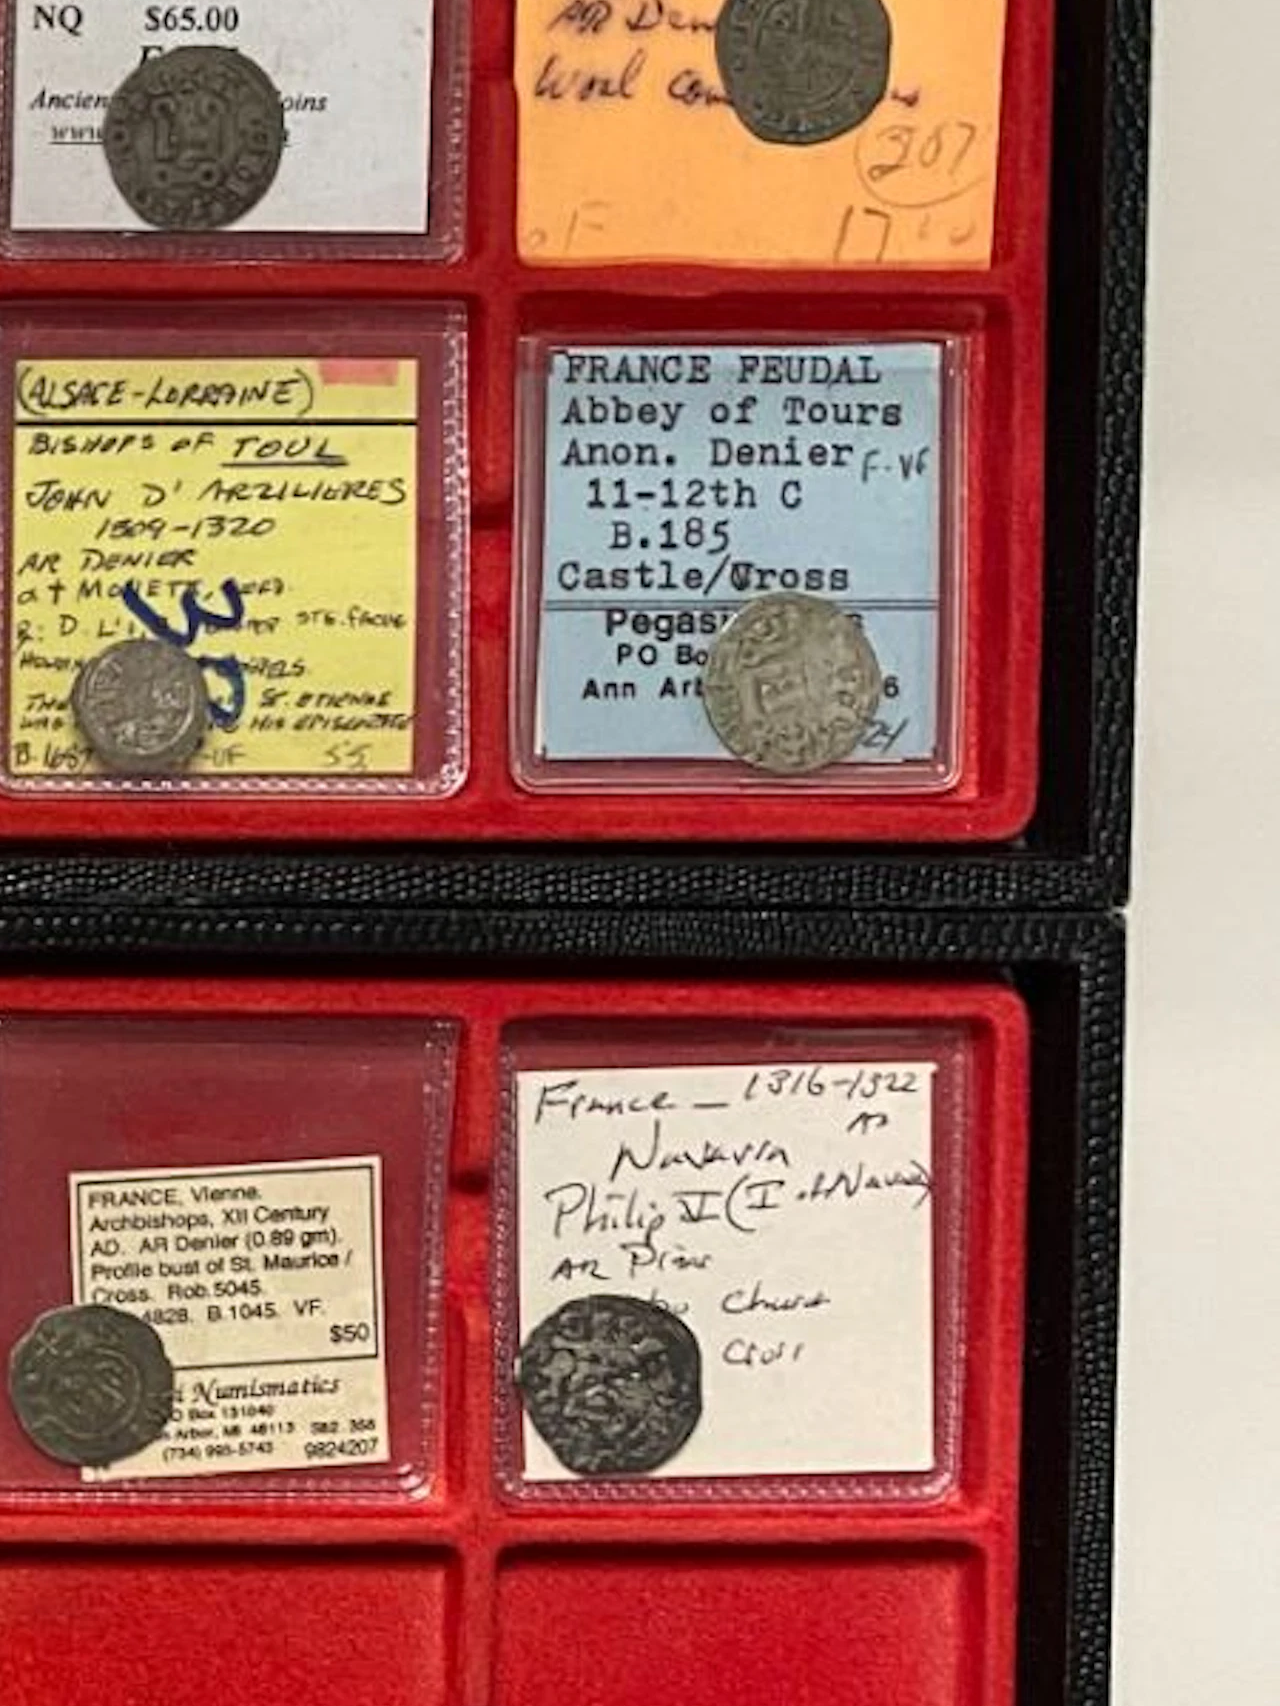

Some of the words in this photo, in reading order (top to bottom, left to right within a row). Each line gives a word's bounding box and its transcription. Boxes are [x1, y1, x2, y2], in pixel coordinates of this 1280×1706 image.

[564, 354, 711, 385] FRANCE
[739, 356, 882, 385] FEUDAL
[561, 397, 685, 432] Abbey
[710, 397, 757, 426] of
[783, 397, 903, 426] Tours
[233, 435, 347, 460] TOUL
[561, 439, 677, 468] Anon.
[711, 439, 854, 468] Denier
[587, 480, 757, 509] 11-12th
[780, 481, 803, 510] C
[610, 520, 731, 554] B.185
[19, 551, 60, 575] AR
[80, 548, 197, 570] DENIER
[89, 1210, 215, 1234] Archbishops,
[253, 1206, 330, 1225] Century
[329, 1324, 370, 1343] $50
[193, 1375, 342, 1404] Numismatics
